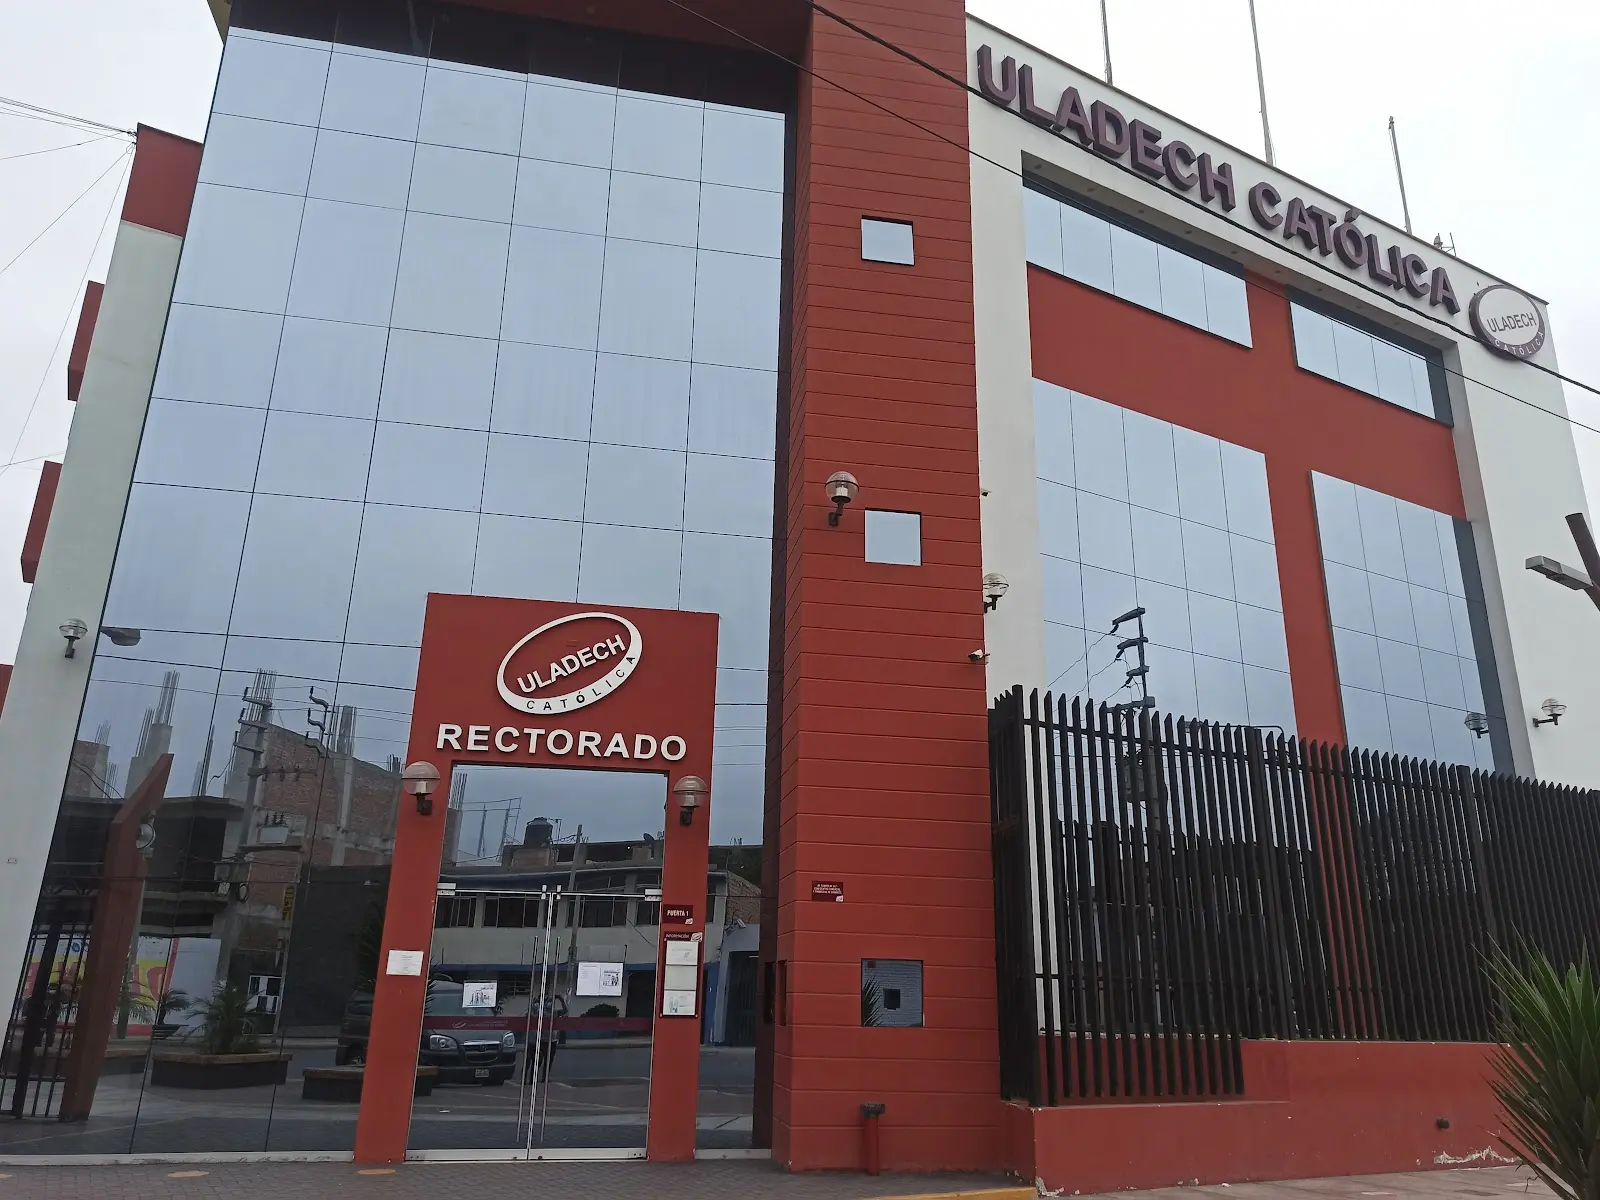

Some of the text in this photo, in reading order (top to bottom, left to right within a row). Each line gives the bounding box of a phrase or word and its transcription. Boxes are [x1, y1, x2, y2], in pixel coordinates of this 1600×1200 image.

[976, 43, 1461, 315] ULADECH CATÓLICA
[1486, 312, 1537, 333] ULADECH
[1494, 331, 1544, 356] CATÓLICA
[516, 633, 627, 694] ULADECH
[526, 655, 636, 712] CATÓLICA
[435, 722, 688, 762] RECTORADO
[666, 909, 686, 917] PUERTA
